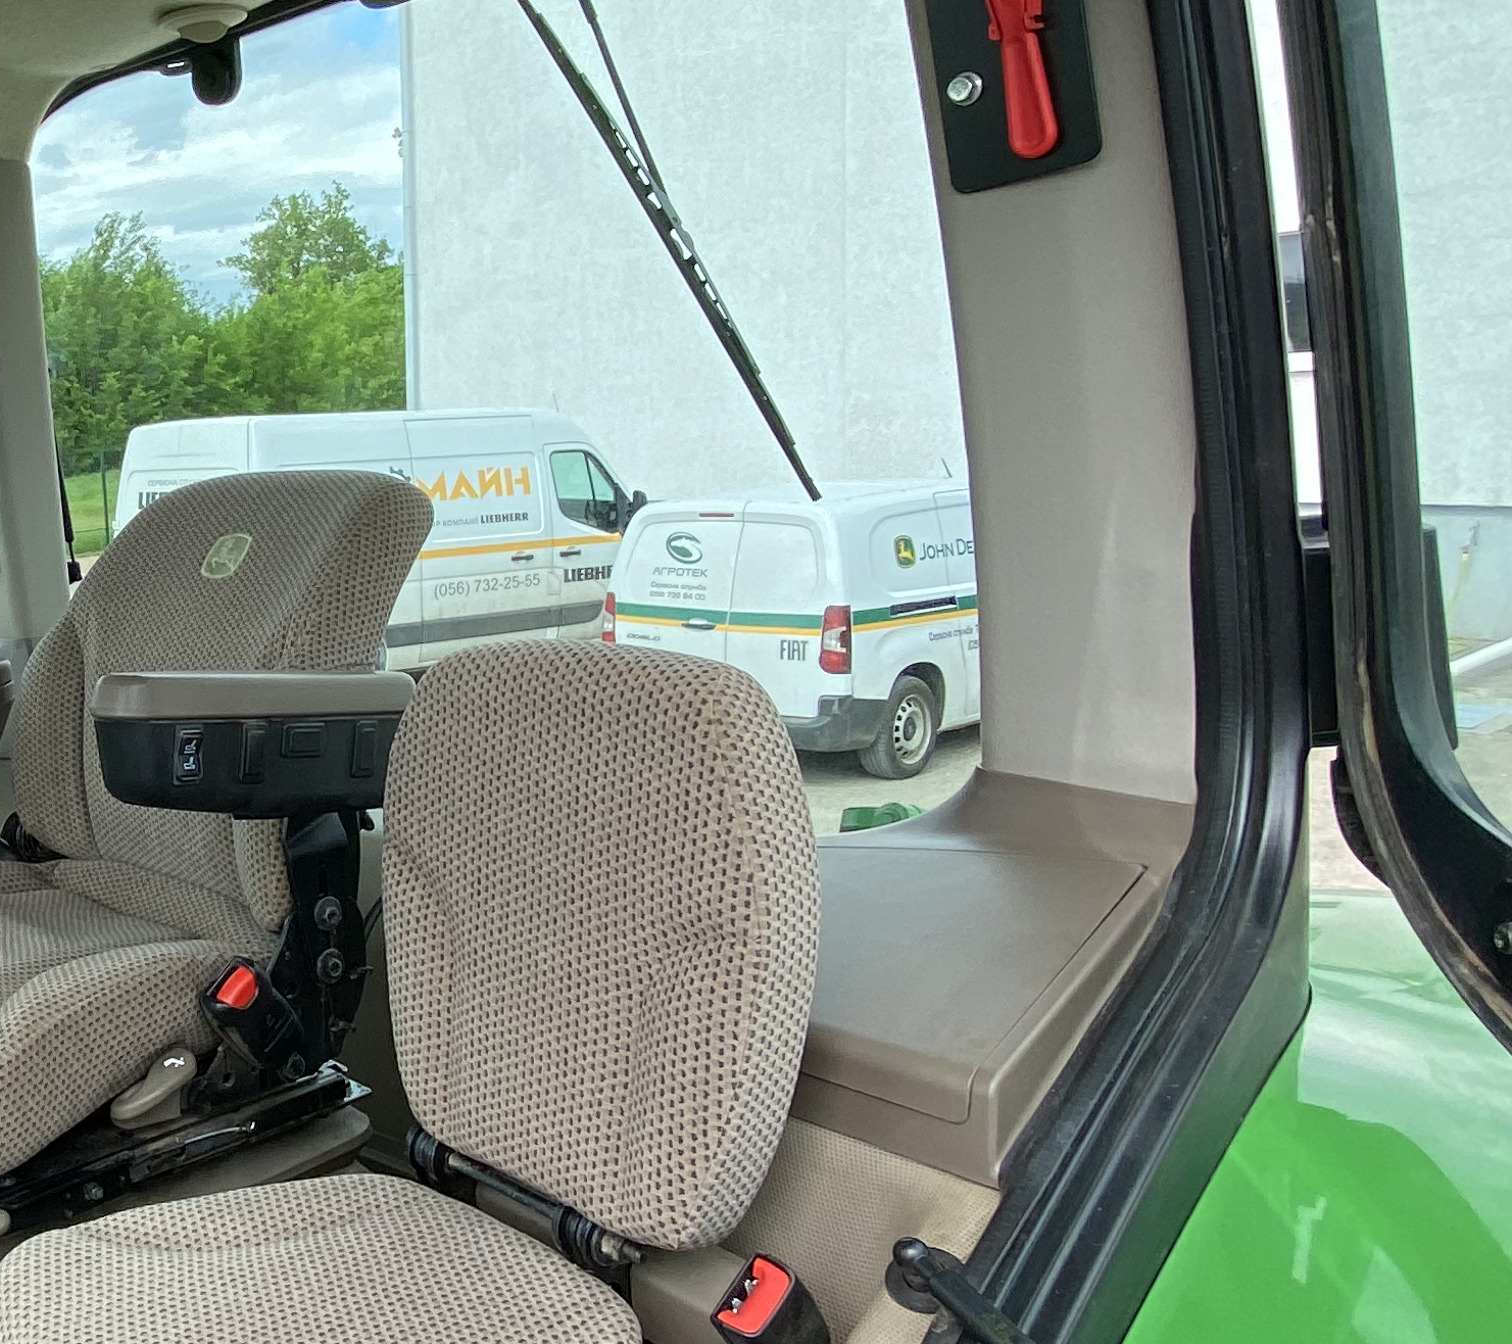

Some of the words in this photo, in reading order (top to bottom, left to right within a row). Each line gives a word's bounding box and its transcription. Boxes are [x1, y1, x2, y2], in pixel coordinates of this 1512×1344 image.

[480, 512, 529, 524] LIEBHERR
[920, 542, 955, 561] JOHN
[652, 566, 708, 578] АГРОТЕК
[434, 580, 471, 600] (056)
[475, 573, 541, 593] 732-25-55
[780, 639, 809, 661] FIAT
